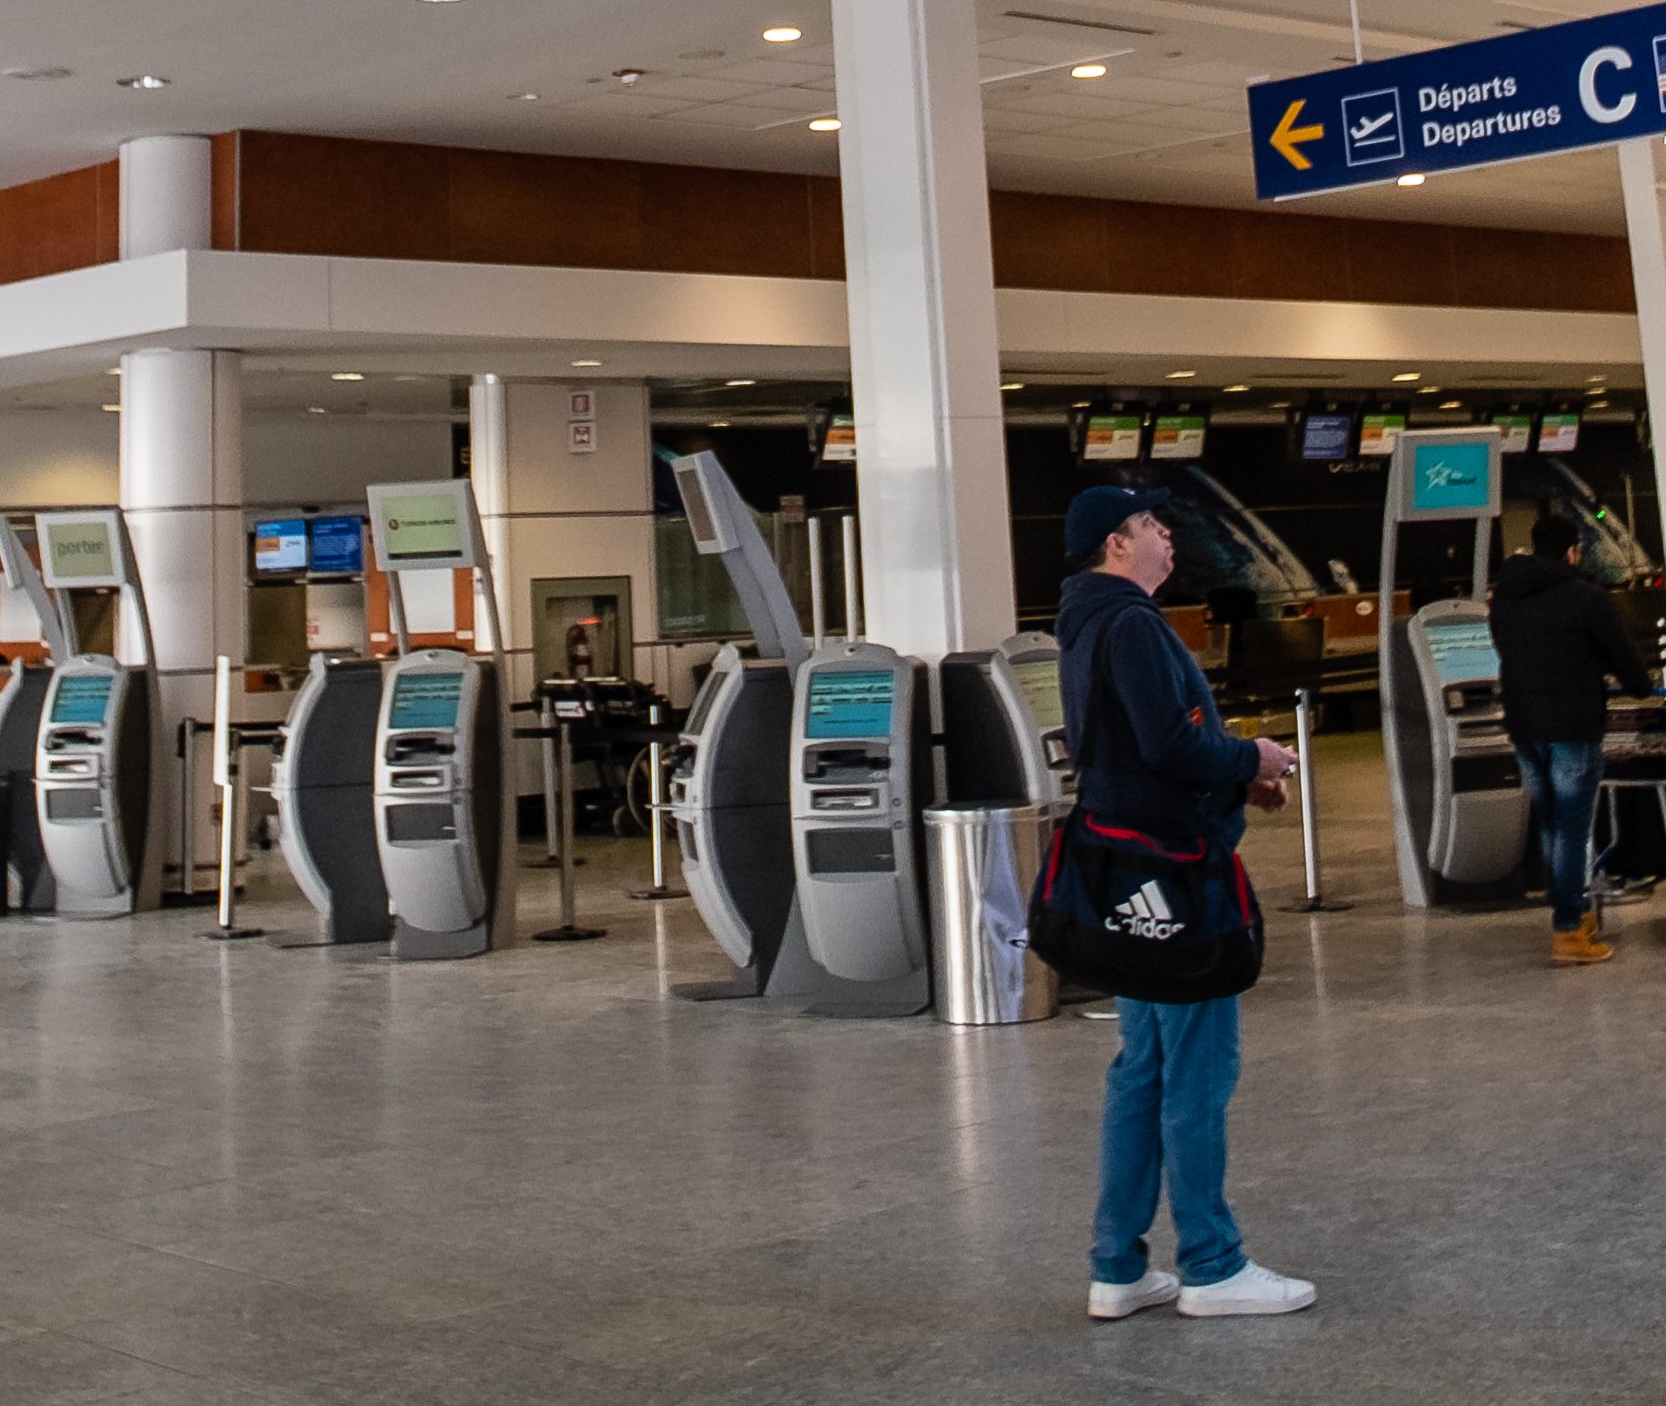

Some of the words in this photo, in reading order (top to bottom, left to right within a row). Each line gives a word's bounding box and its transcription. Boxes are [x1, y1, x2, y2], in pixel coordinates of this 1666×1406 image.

[1417, 72, 1518, 113] Départs
[1579, 46, 1637, 124] C
[1421, 102, 1562, 149] Departures
[56, 540, 104, 558] porter
